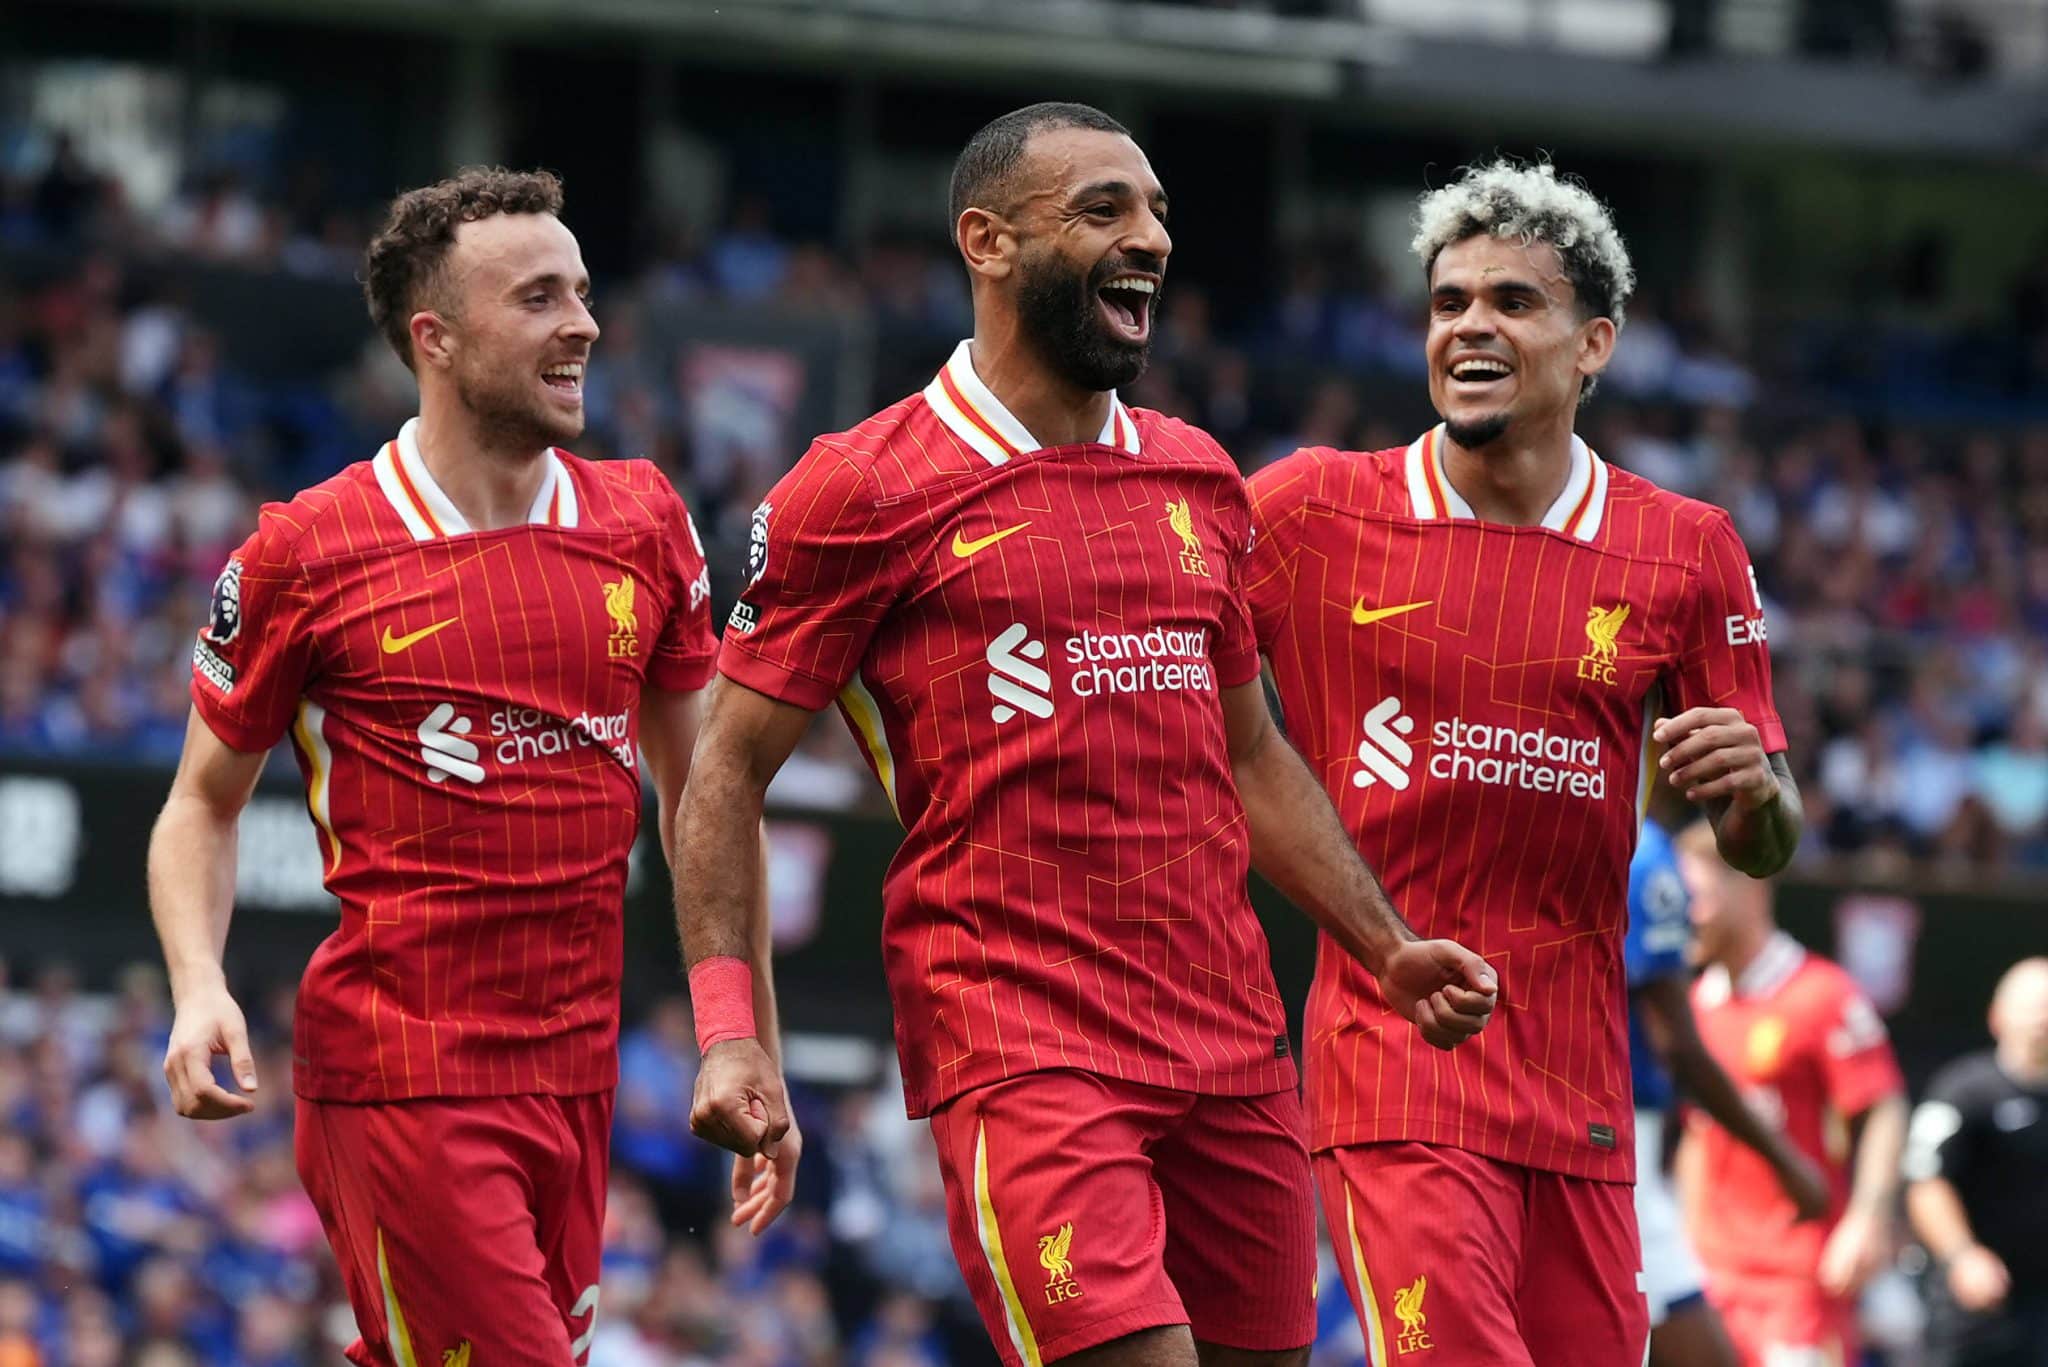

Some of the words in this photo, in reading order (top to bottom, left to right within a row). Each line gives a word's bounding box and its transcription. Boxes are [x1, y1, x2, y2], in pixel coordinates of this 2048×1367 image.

[1065, 625, 1206, 664] standard
[1071, 658, 1212, 697] chartered
[490, 704, 630, 742] stadard
[1432, 716, 1601, 767] standard
[1429, 748, 1606, 800] chartered
